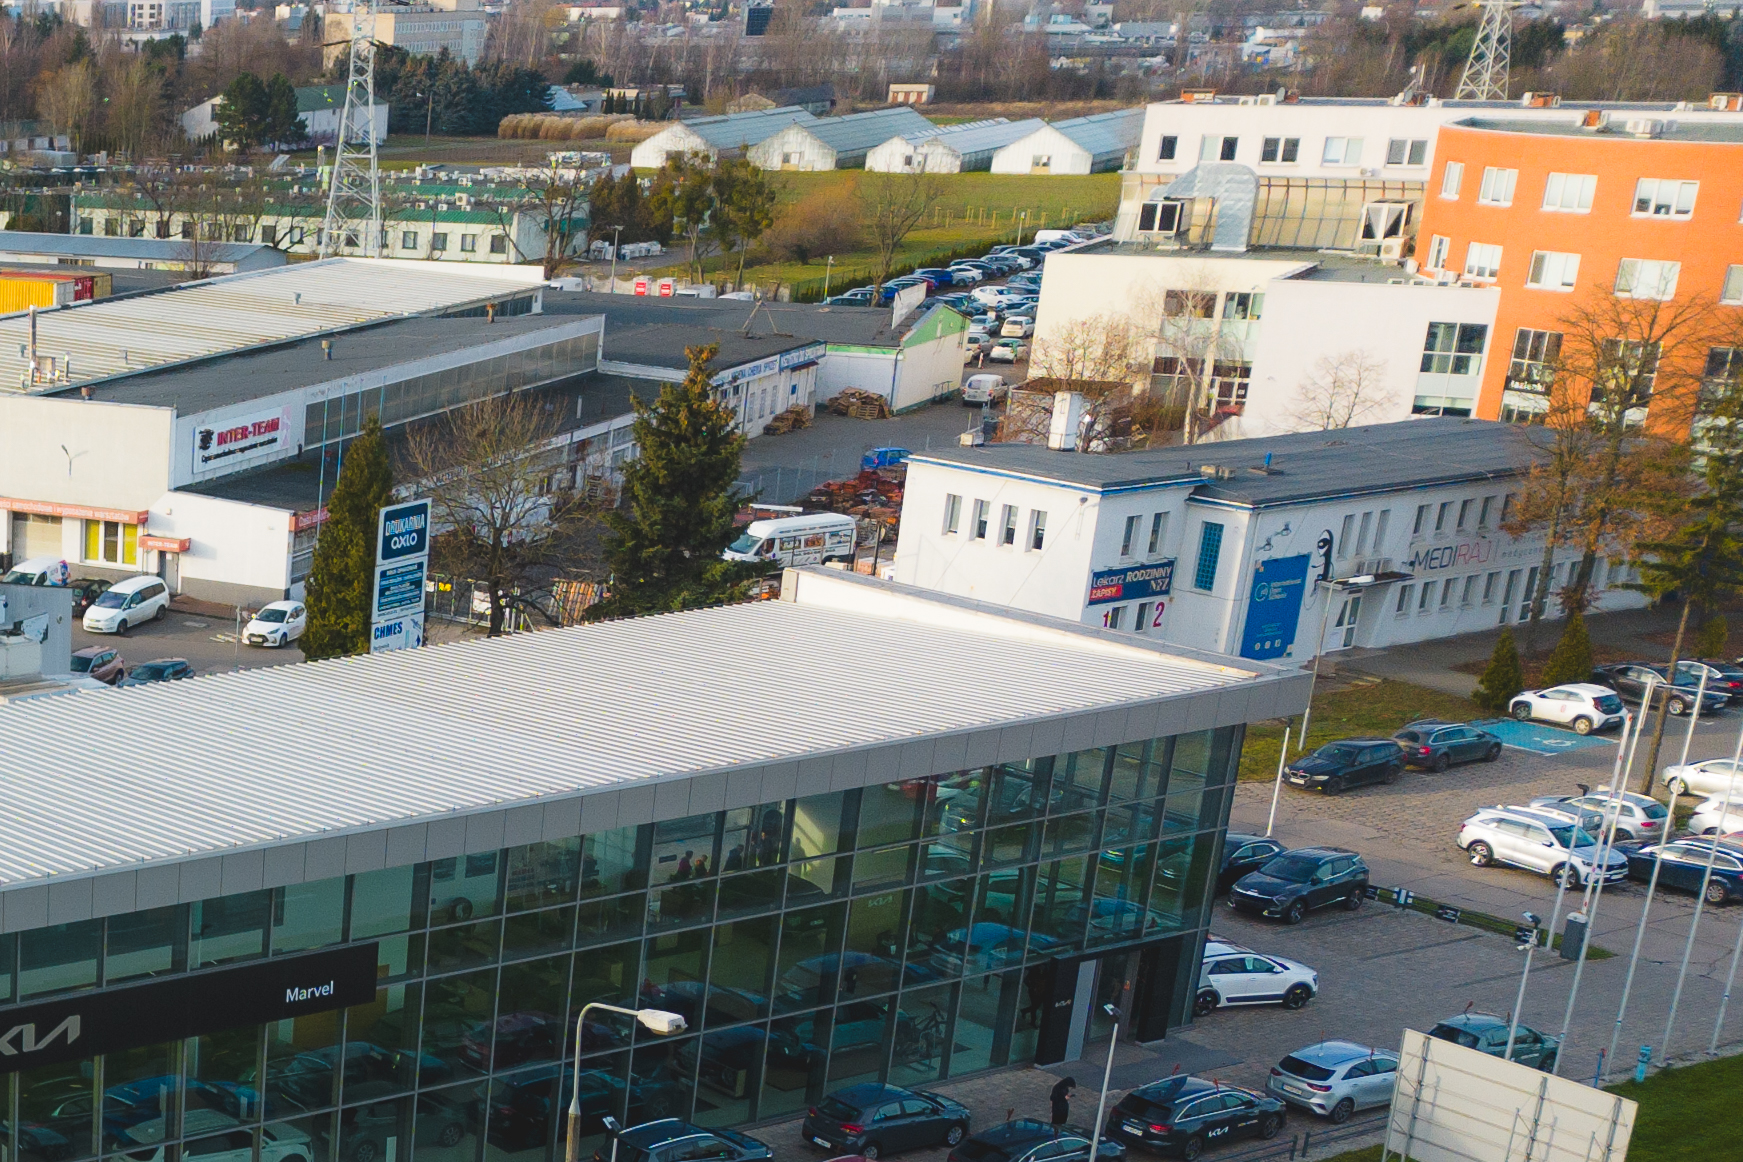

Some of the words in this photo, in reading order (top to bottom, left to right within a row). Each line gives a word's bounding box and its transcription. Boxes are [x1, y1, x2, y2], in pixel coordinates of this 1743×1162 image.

[216, 417, 280, 446] INTER-TEAM
[1413, 540, 1492, 572] MEDIRAJ
[1093, 574, 1125, 588] Lekarz
[1126, 565, 1173, 583] RODZINNY
[1103, 610, 1110, 627] 1
[1152, 601, 1165, 628] 2
[373, 621, 403, 640] CHMES
[286, 980, 335, 1003] Marvel
